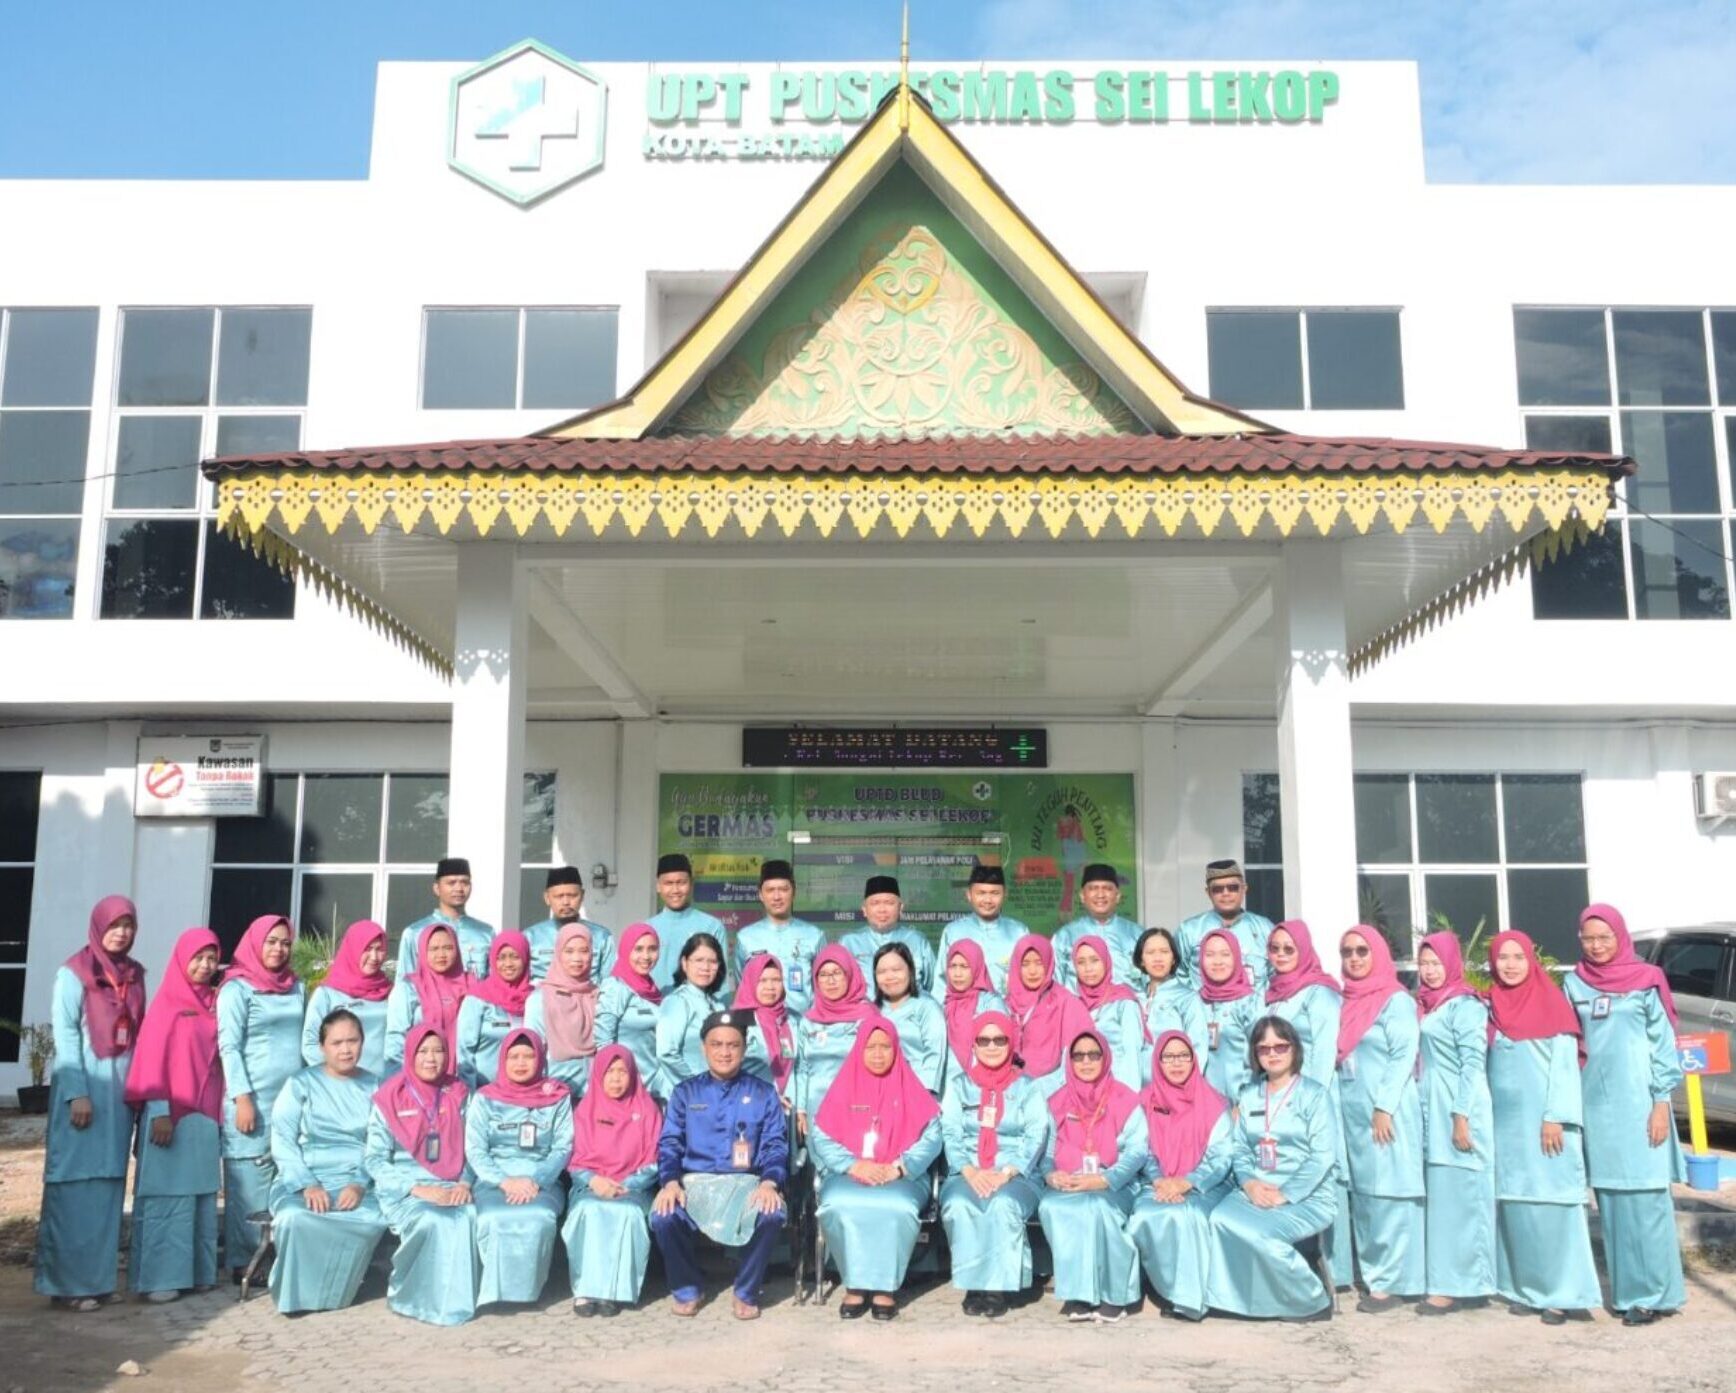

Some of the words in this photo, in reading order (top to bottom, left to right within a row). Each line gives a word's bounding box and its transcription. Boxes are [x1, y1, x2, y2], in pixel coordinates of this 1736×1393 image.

[646, 72, 748, 124] UPT
[1094, 71, 1169, 124] SEI
[1188, 71, 1340, 124] LEKOP
[642, 134, 729, 161] KOTA
[737, 134, 844, 161] BATAM
[197, 756, 254, 769] Kawasan
[854, 788, 896, 801] UPTD
[678, 813, 775, 837] GERMAS
[835, 855, 854, 865] VISI
[834, 911, 855, 921] MISI
